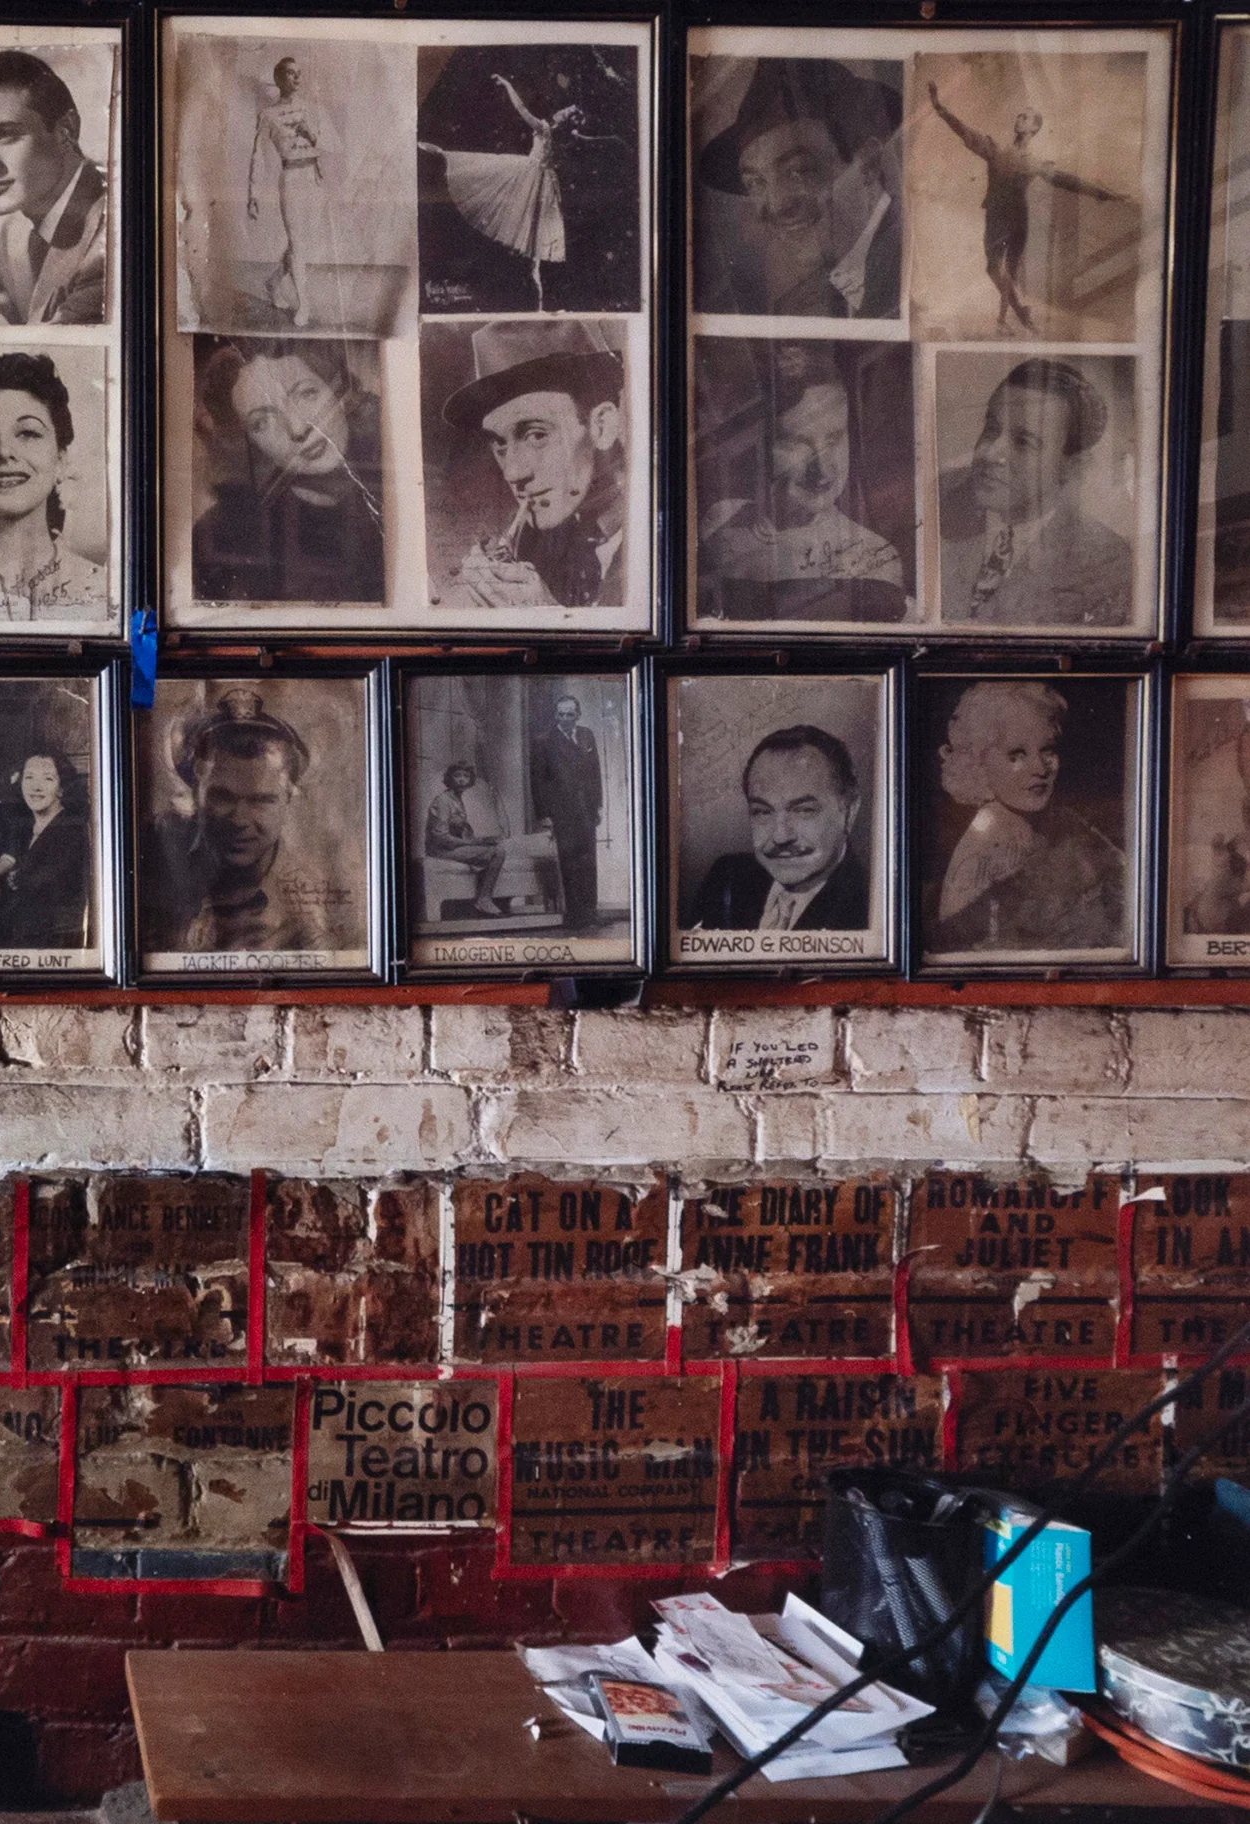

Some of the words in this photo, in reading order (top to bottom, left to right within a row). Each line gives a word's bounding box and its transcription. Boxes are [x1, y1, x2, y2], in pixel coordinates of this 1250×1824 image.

[434, 945, 515, 962] IMOGENE
[522, 945, 577, 962] COCA
[680, 937, 755, 953] EDWARD
[779, 936, 865, 954] ROBINSON
[1207, 940, 1250, 955] BER
[38, 955, 72, 968] LUNT
[181, 954, 239, 971] JACKIE
[246, 953, 327, 971] COOPER
[753, 1041, 778, 1053] YOU
[485, 1191, 543, 1233] CAT
[558, 1190, 602, 1232] ON
[614, 1193, 633, 1231] A
[760, 1186, 839, 1226] DIARY
[853, 1186, 887, 1225] OF
[980, 1212, 1055, 1234] AND
[457, 1240, 515, 1280] HOT
[527, 1241, 575, 1281] TIN
[694, 1234, 774, 1273] ANNE
[788, 1233, 881, 1273] FRANK
[955, 1236, 1075, 1269] JULIET
[1156, 1225, 1192, 1267] IN
[928, 1319, 1095, 1346] THEATRE
[1024, 1377, 1099, 1401] FIVE
[312, 1389, 491, 1434] Piccolo
[587, 1388, 647, 1431] THE
[336, 1433, 489, 1480] Teatro
[329, 1479, 487, 1522] Milano
[529, 1524, 696, 1553] THEATRE
